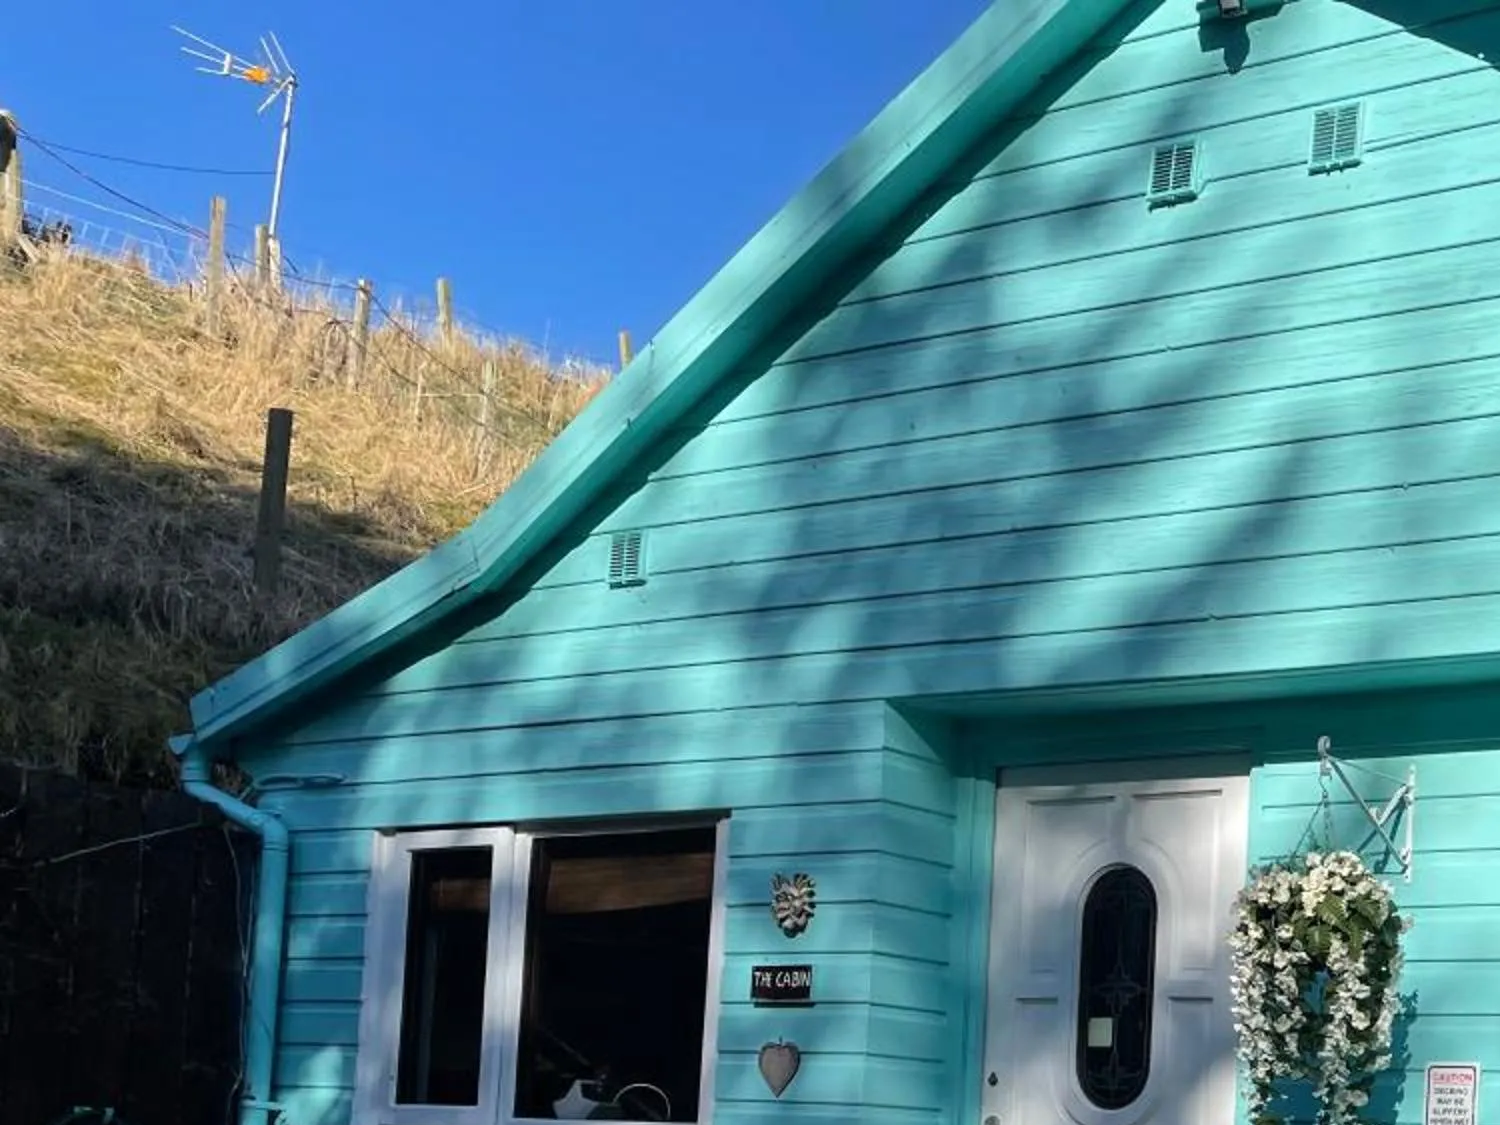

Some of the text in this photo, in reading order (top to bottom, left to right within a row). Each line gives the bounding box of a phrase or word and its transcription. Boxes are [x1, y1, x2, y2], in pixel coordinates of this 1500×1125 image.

[775, 971, 811, 987] CABIN
[1432, 1073, 1472, 1082] CAUTION
[1433, 1108, 1468, 1116] SLIPPERY
[1430, 1117, 1470, 1125] WHEN WET
